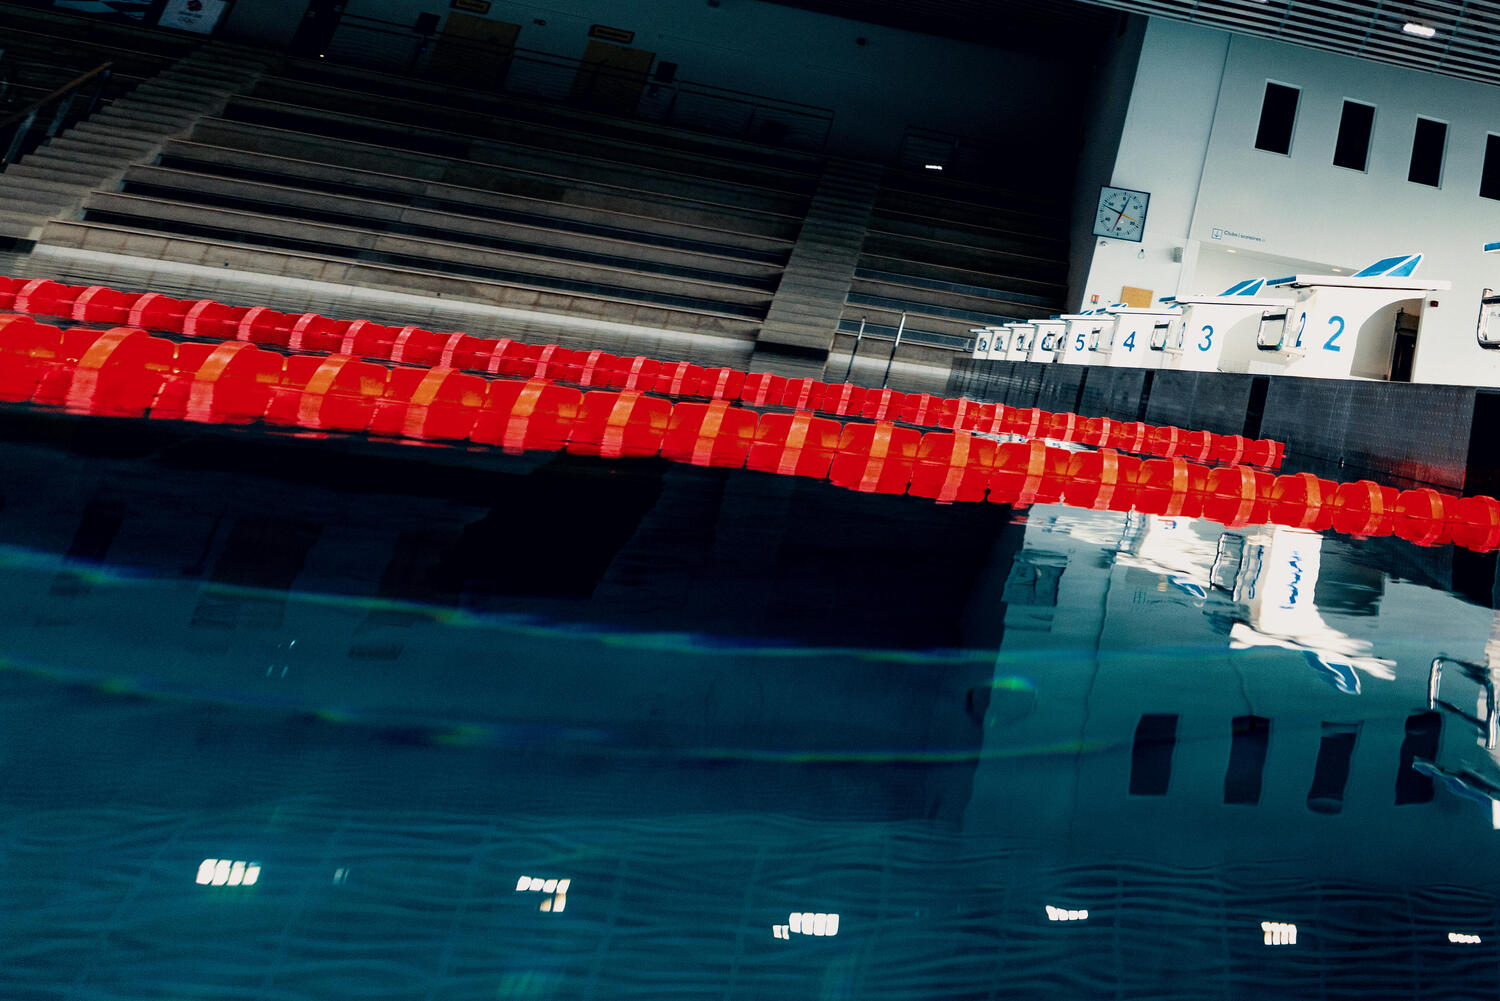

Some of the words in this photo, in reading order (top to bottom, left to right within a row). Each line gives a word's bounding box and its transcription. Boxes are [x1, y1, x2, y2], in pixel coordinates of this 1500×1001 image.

[1074, 333, 1086, 351] 5
[1123, 331, 1137, 352] 4
[1198, 325, 1214, 352] 3
[1323, 315, 1345, 352] 2
